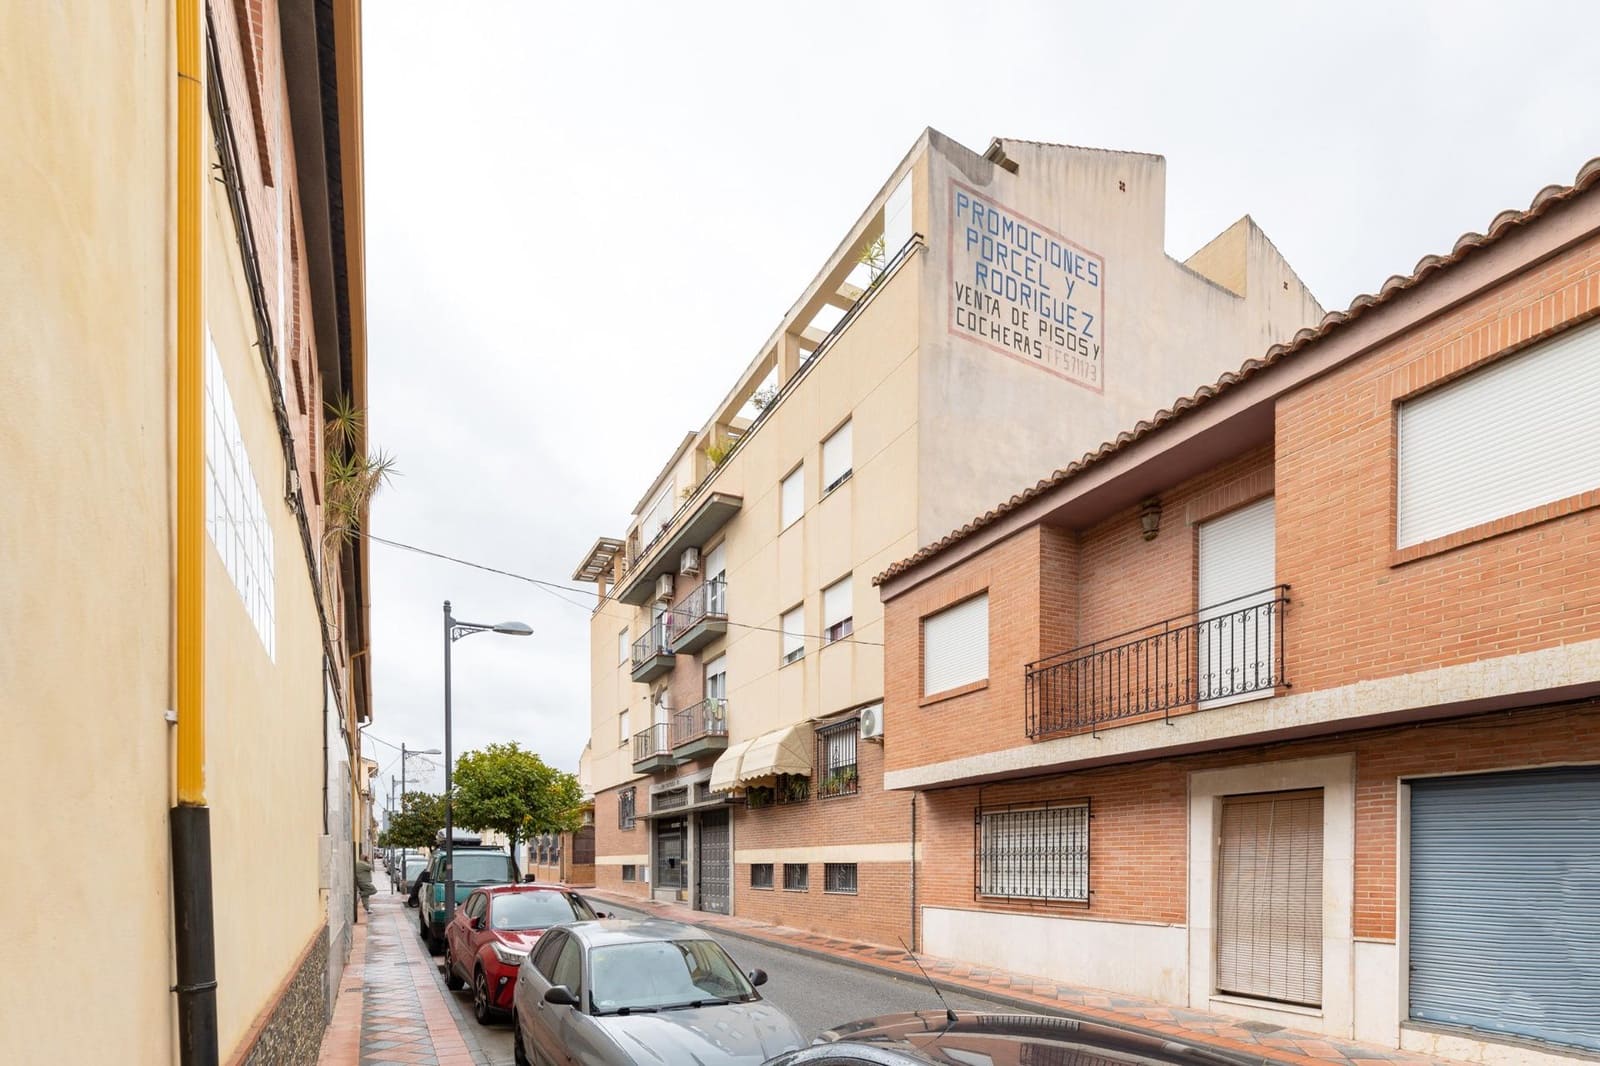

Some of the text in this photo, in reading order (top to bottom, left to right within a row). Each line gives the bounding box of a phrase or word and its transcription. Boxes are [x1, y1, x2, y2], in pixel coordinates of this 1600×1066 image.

[957, 191, 1098, 287] PROMOCIONES
[967, 227, 1075, 299] PORCEL Y
[955, 281, 1100, 361] VENTA DE PISOS Y
[956, 307, 1042, 359] COCHERAS
[976, 261, 1094, 338] RODRIGUEZ
